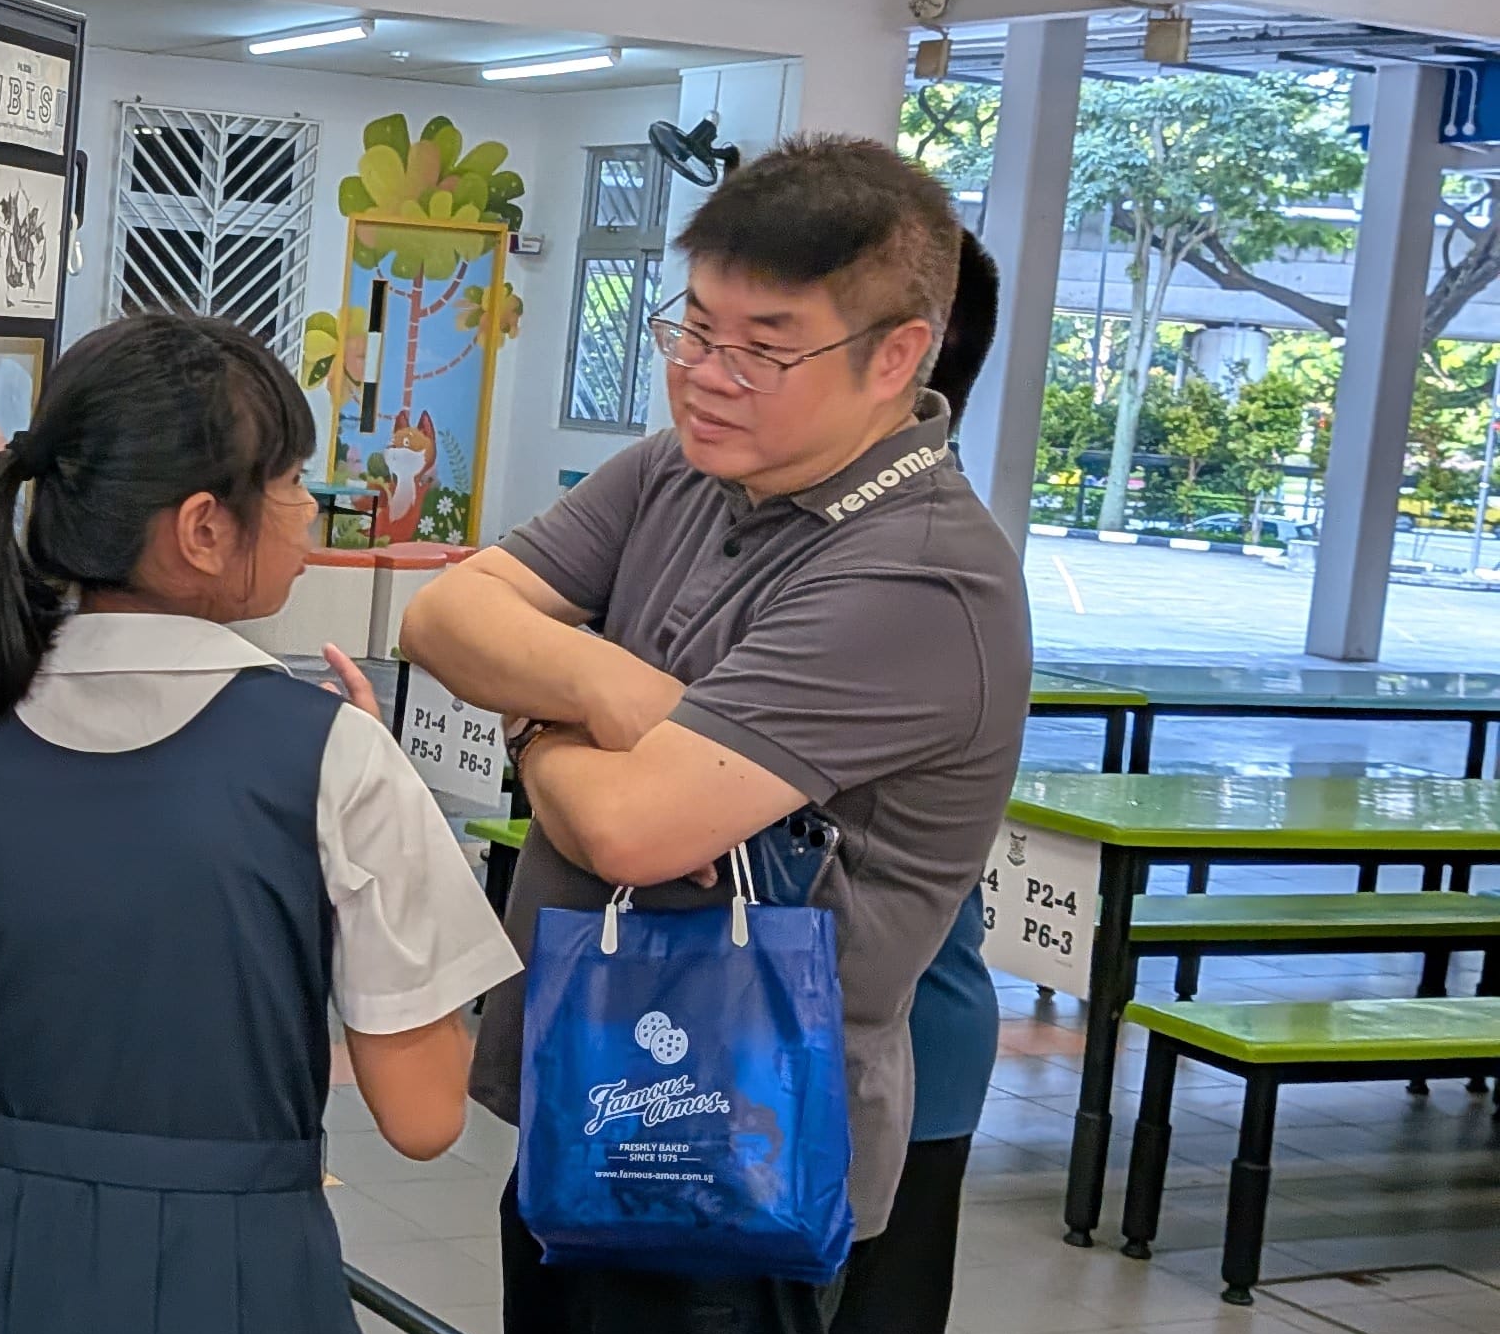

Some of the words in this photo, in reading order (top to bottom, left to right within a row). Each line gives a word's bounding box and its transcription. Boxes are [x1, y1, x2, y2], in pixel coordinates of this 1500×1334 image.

[825, 447, 935, 522] renoma
[414, 708, 446, 733] P1-4
[462, 720, 496, 746] P2-4
[410, 737, 443, 762] P5-3
[459, 750, 492, 776] P6-3
[1026, 877, 1077, 916] P2-4
[1023, 917, 1073, 955] P6-3
[584, 1075, 695, 1135] Famous
[619, 1143, 657, 1152] FRESHLY
[658, 1143, 689, 1153] BAKED
[629, 1153, 655, 1162] SINCE
[595, 1169, 714, 1183] www.famous-amos.com.sg
